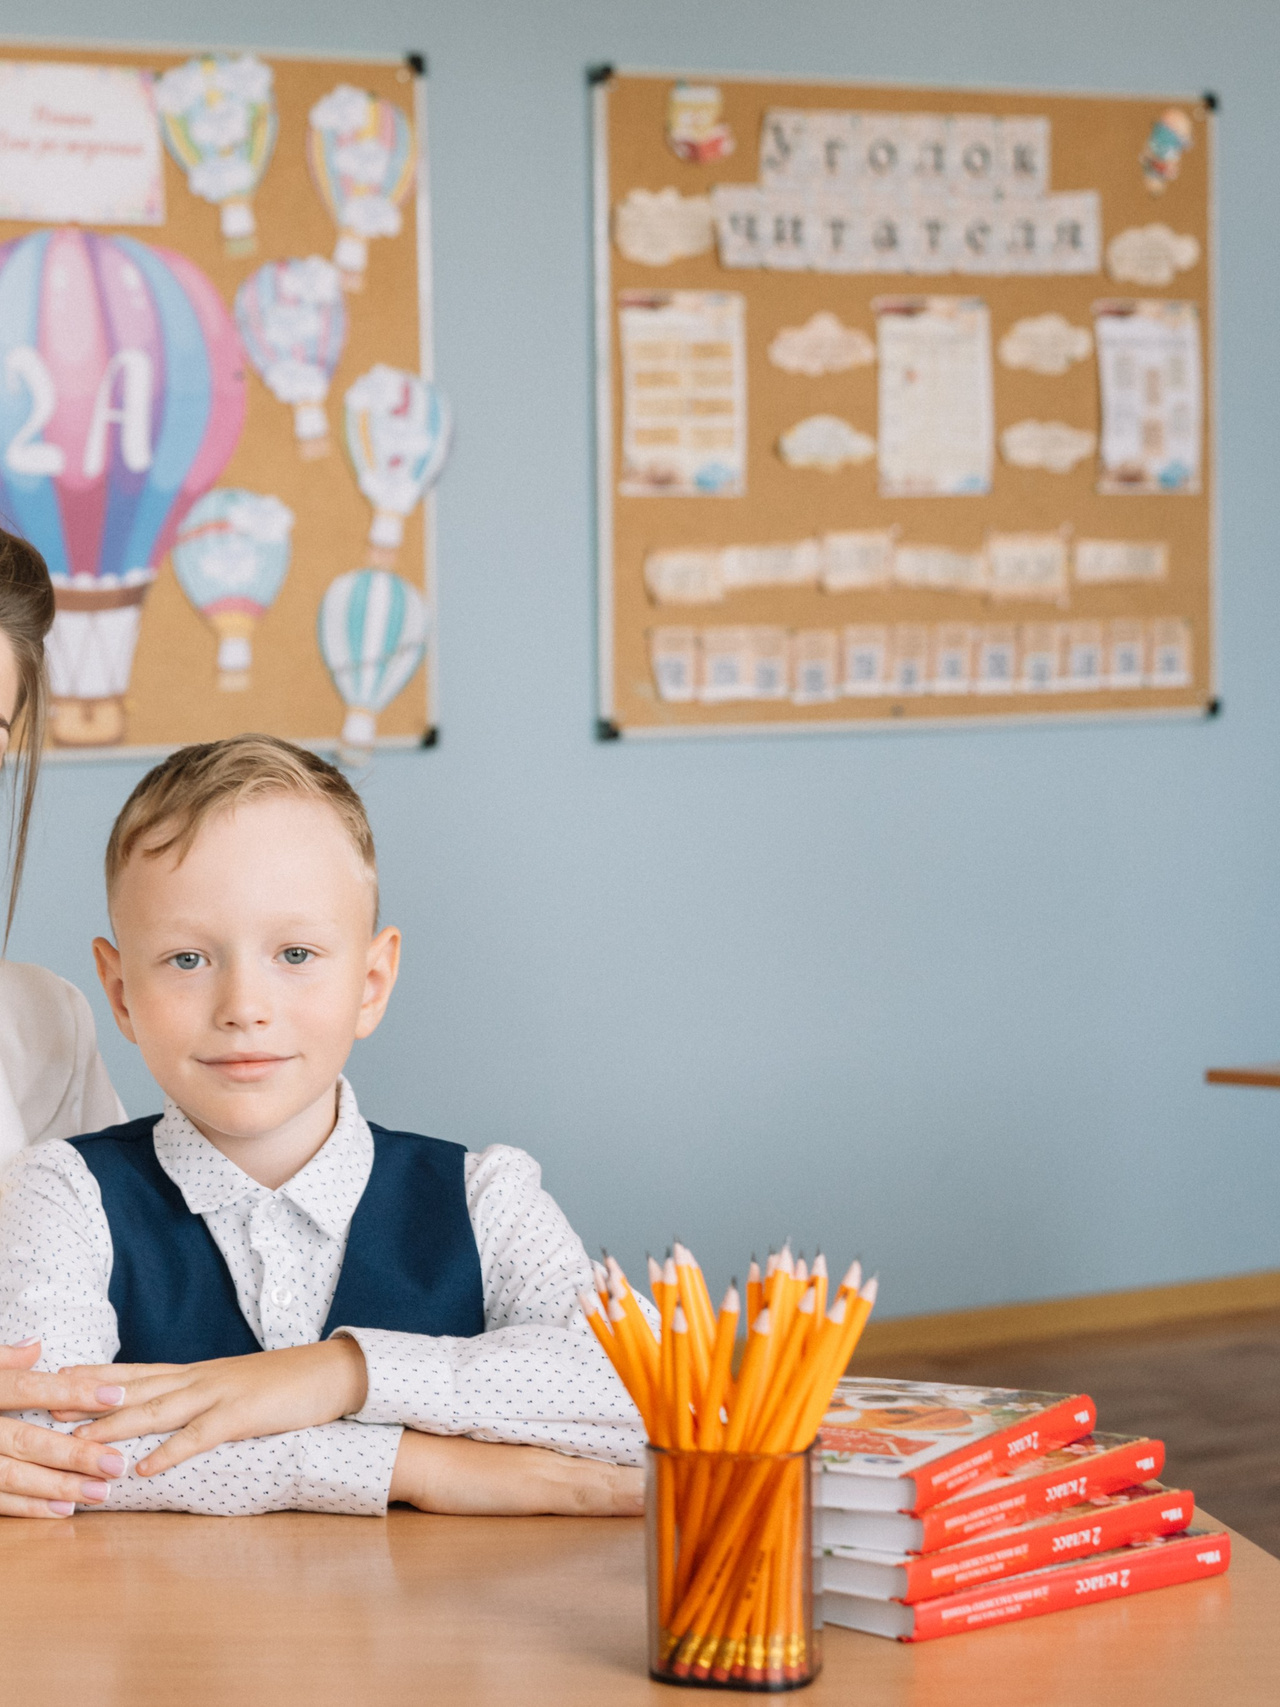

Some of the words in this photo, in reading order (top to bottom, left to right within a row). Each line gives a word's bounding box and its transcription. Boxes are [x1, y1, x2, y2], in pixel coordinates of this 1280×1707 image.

[764, 122, 1038, 176] Уголок
[729, 212, 1085, 253] читателя
[1032, 1431, 1039, 1450] 2
[1079, 1477, 1087, 1495] 2
[1052, 1530, 1091, 1552] класс
[1093, 1527, 1102, 1546] 2
[1075, 1572, 1118, 1595] класс
[1121, 1569, 1131, 1588] 2
